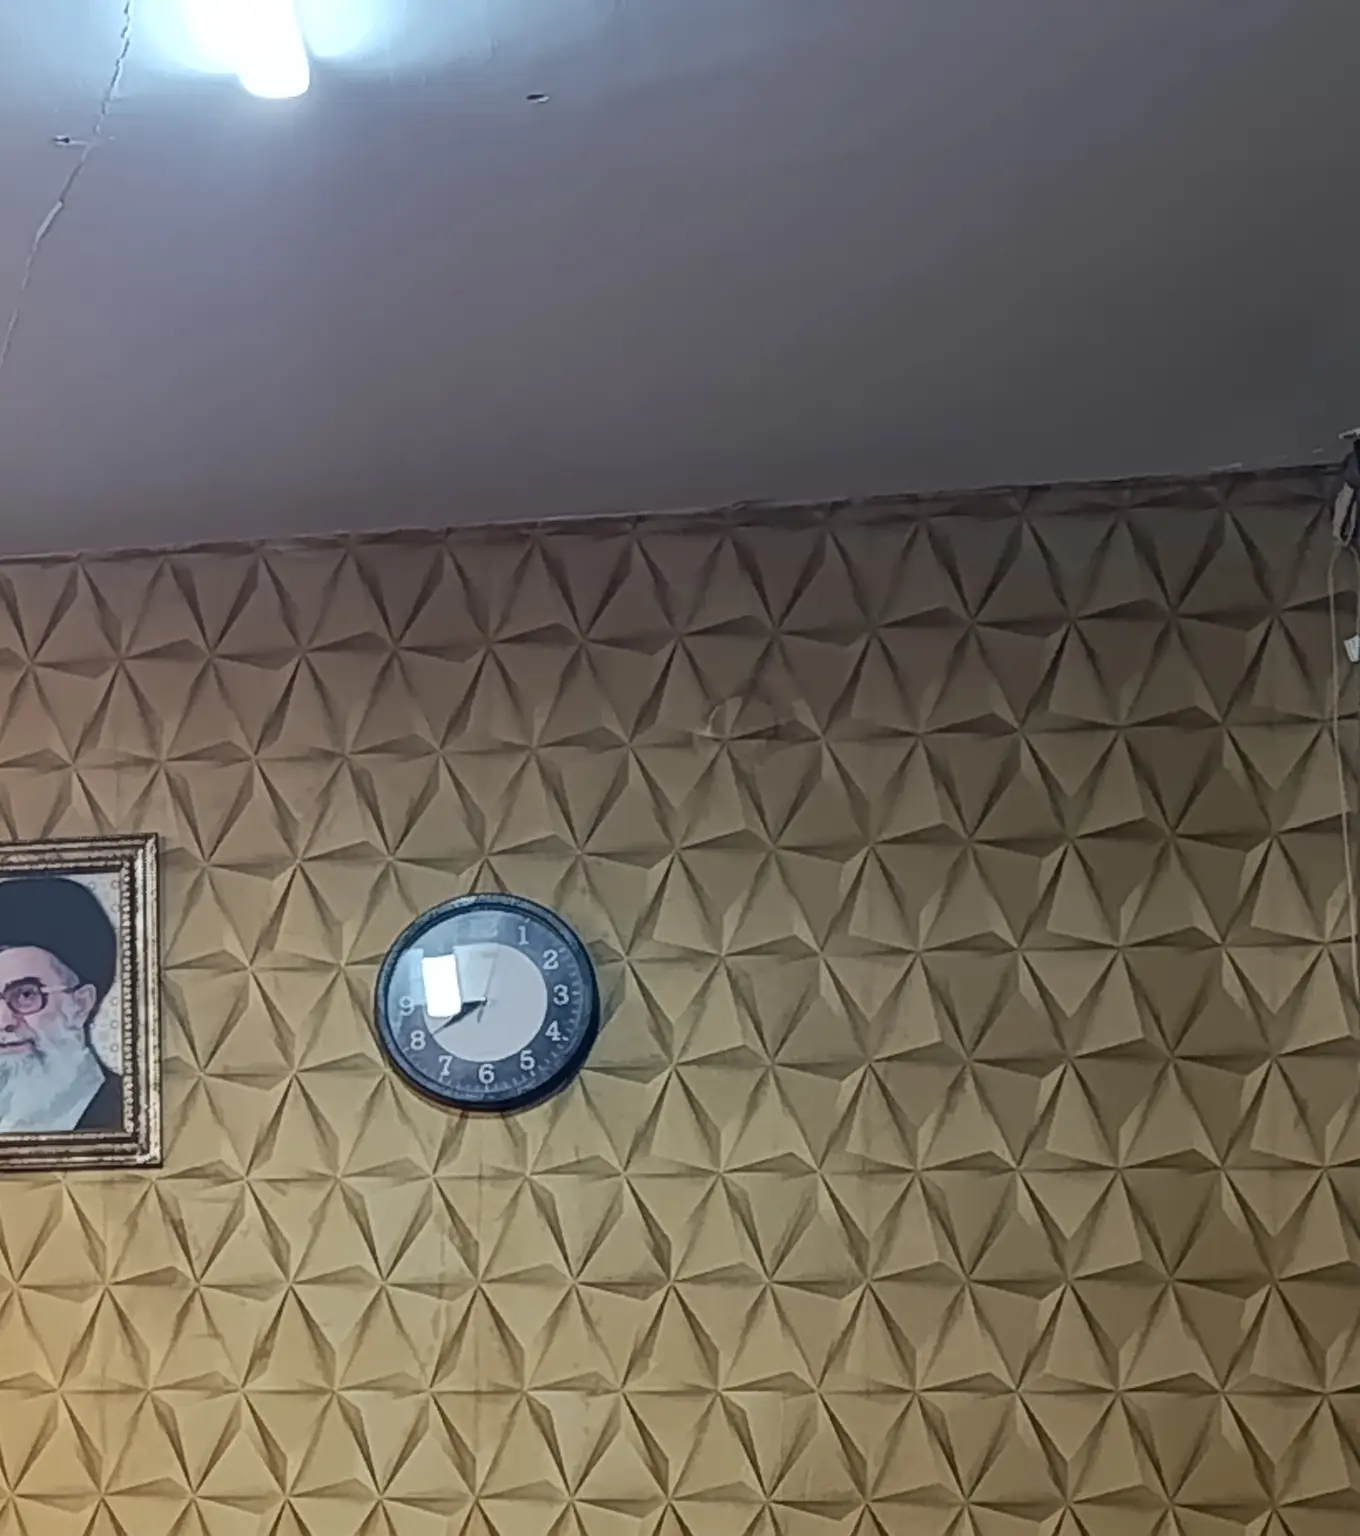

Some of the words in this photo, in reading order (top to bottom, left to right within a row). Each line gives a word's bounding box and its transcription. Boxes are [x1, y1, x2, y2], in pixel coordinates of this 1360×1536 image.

[518, 925, 530, 946] 1
[543, 949, 560, 970] 2
[398, 996, 415, 1016] 9
[553, 984, 569, 1006] 3
[410, 1029, 426, 1051] 8
[545, 1020, 562, 1042] 4
[437, 1055, 453, 1077] 7
[519, 1049, 536, 1071] 5
[478, 1063, 495, 1085] 6
